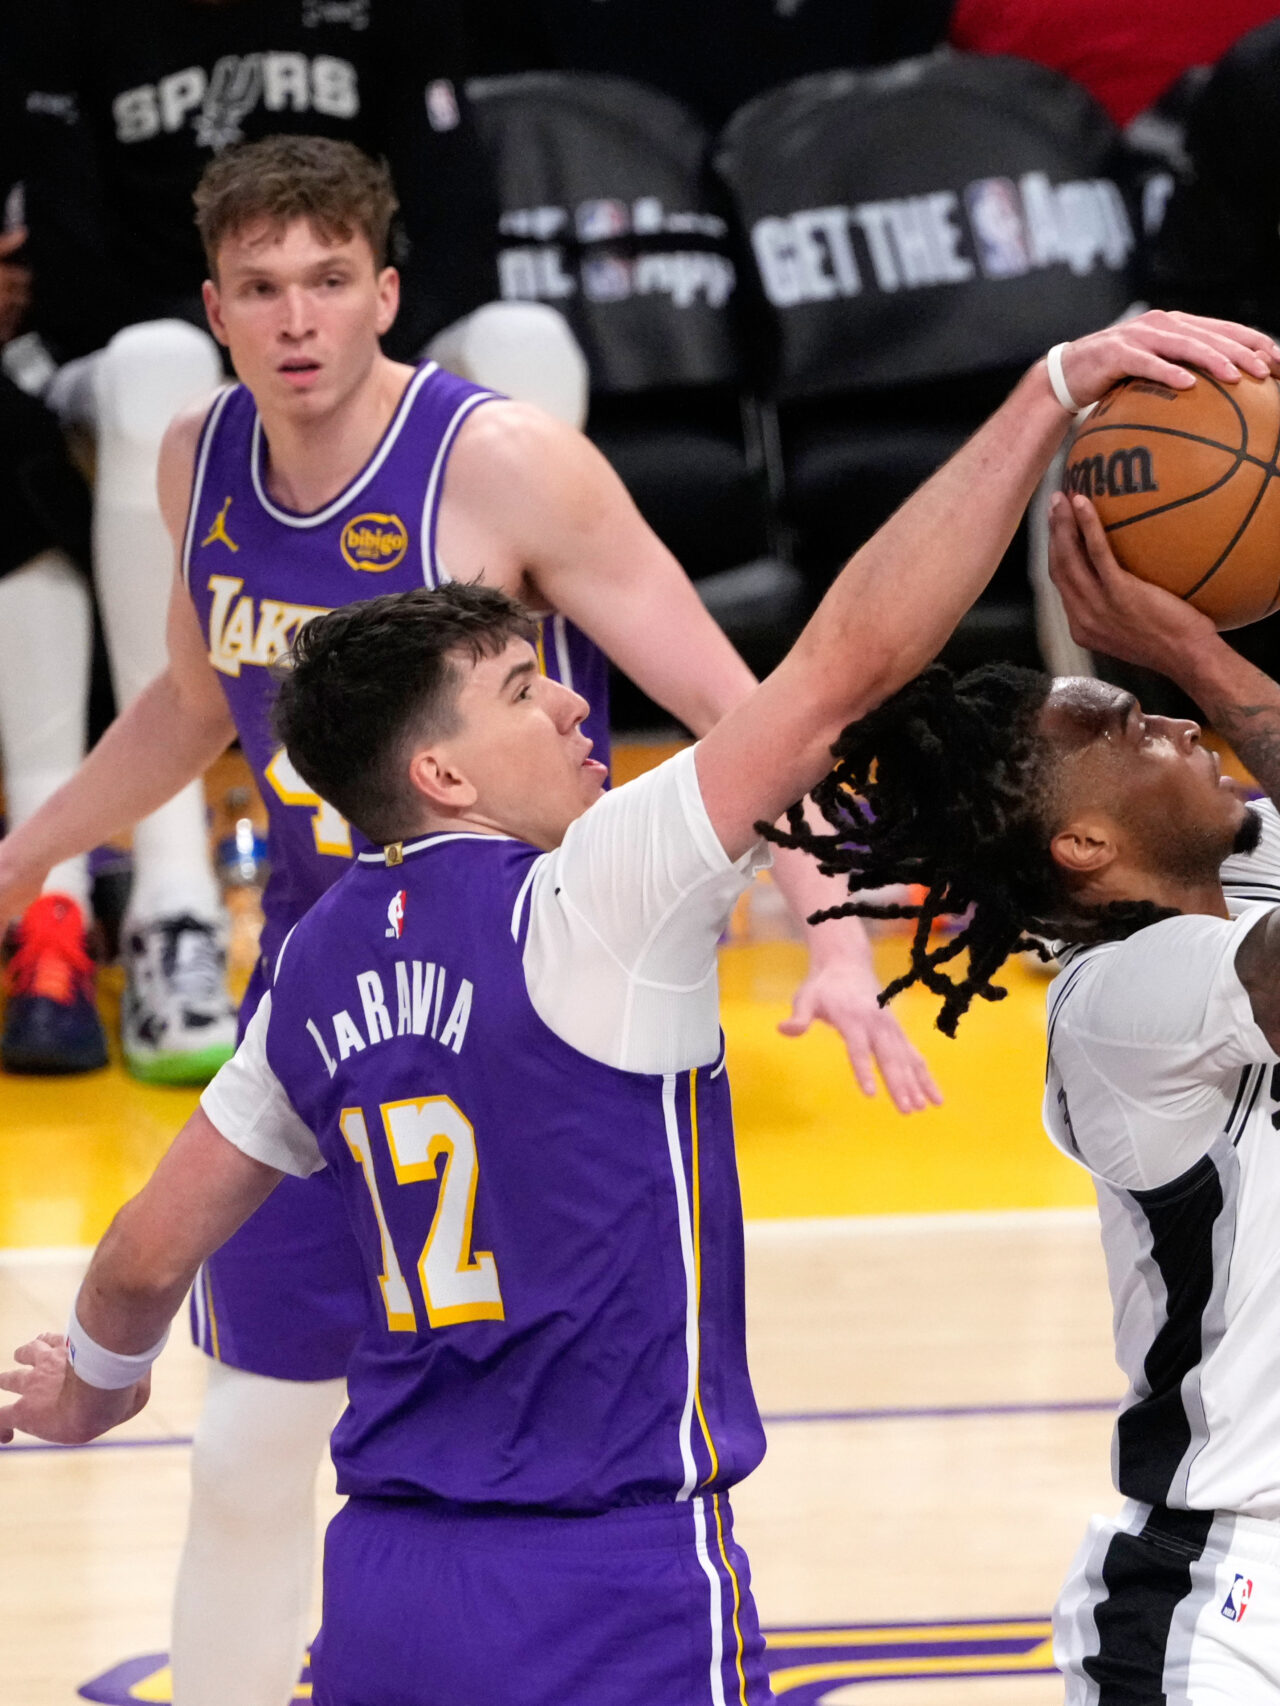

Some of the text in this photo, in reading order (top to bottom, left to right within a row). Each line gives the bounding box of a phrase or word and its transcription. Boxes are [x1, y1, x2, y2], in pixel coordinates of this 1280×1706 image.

[112, 51, 360, 152] SPURS
[750, 206, 863, 309] GET
[853, 190, 977, 295] THE
[348, 527, 403, 556] bibigo
[339, 1093, 505, 1334] 12
